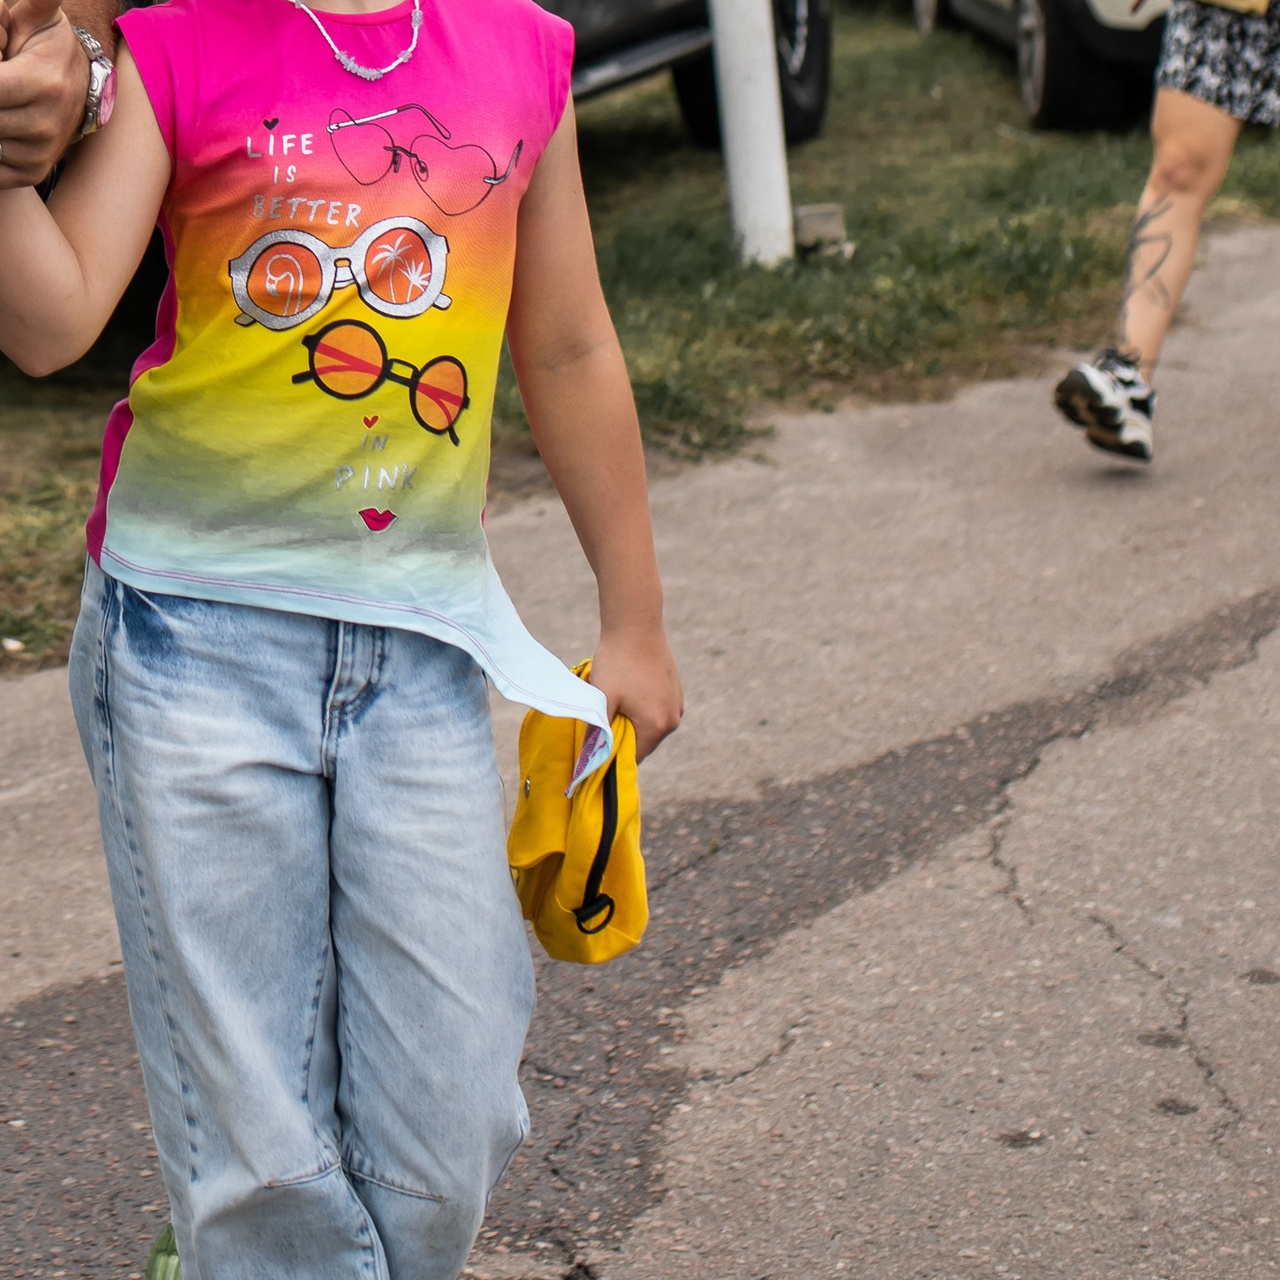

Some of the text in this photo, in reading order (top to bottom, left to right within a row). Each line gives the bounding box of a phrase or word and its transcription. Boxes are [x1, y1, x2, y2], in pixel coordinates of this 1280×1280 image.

[246, 133, 314, 158] LIFE
[273, 165, 297, 184] IS
[253, 194, 363, 228] BETTER
[360, 433, 389, 451] IN
[336, 464, 417, 491] PINK
